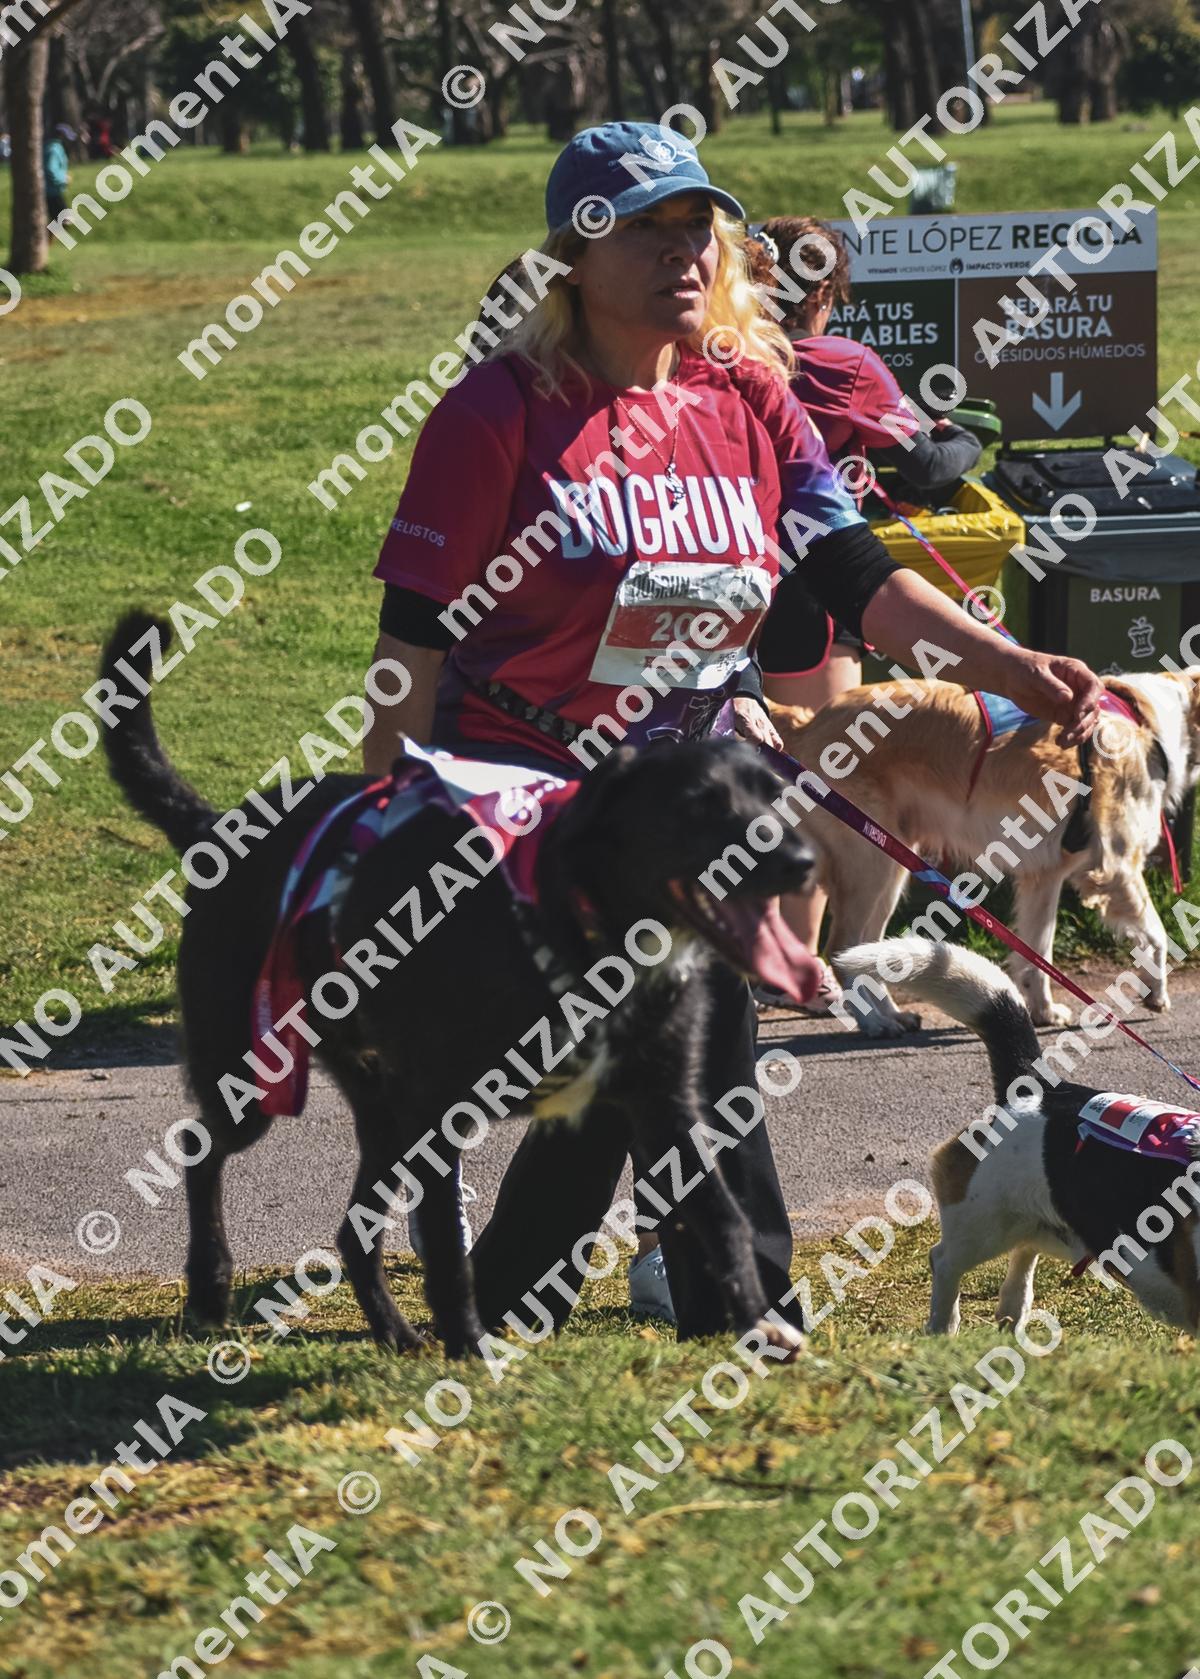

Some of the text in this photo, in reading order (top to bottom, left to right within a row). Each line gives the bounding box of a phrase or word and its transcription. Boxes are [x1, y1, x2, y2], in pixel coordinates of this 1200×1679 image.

[908, 220, 1001, 254] LÓPEZ
[966, 261, 1030, 271] IMPACTO VERDE
[875, 302, 914, 321] TUS
[1086, 294, 1112, 312] TU
[1005, 316, 1112, 340] BASURA
[1069, 342, 1145, 359] HÚMEDOS
[549, 473, 766, 558] DOGRUN
[1090, 586, 1161, 603] BASURA
